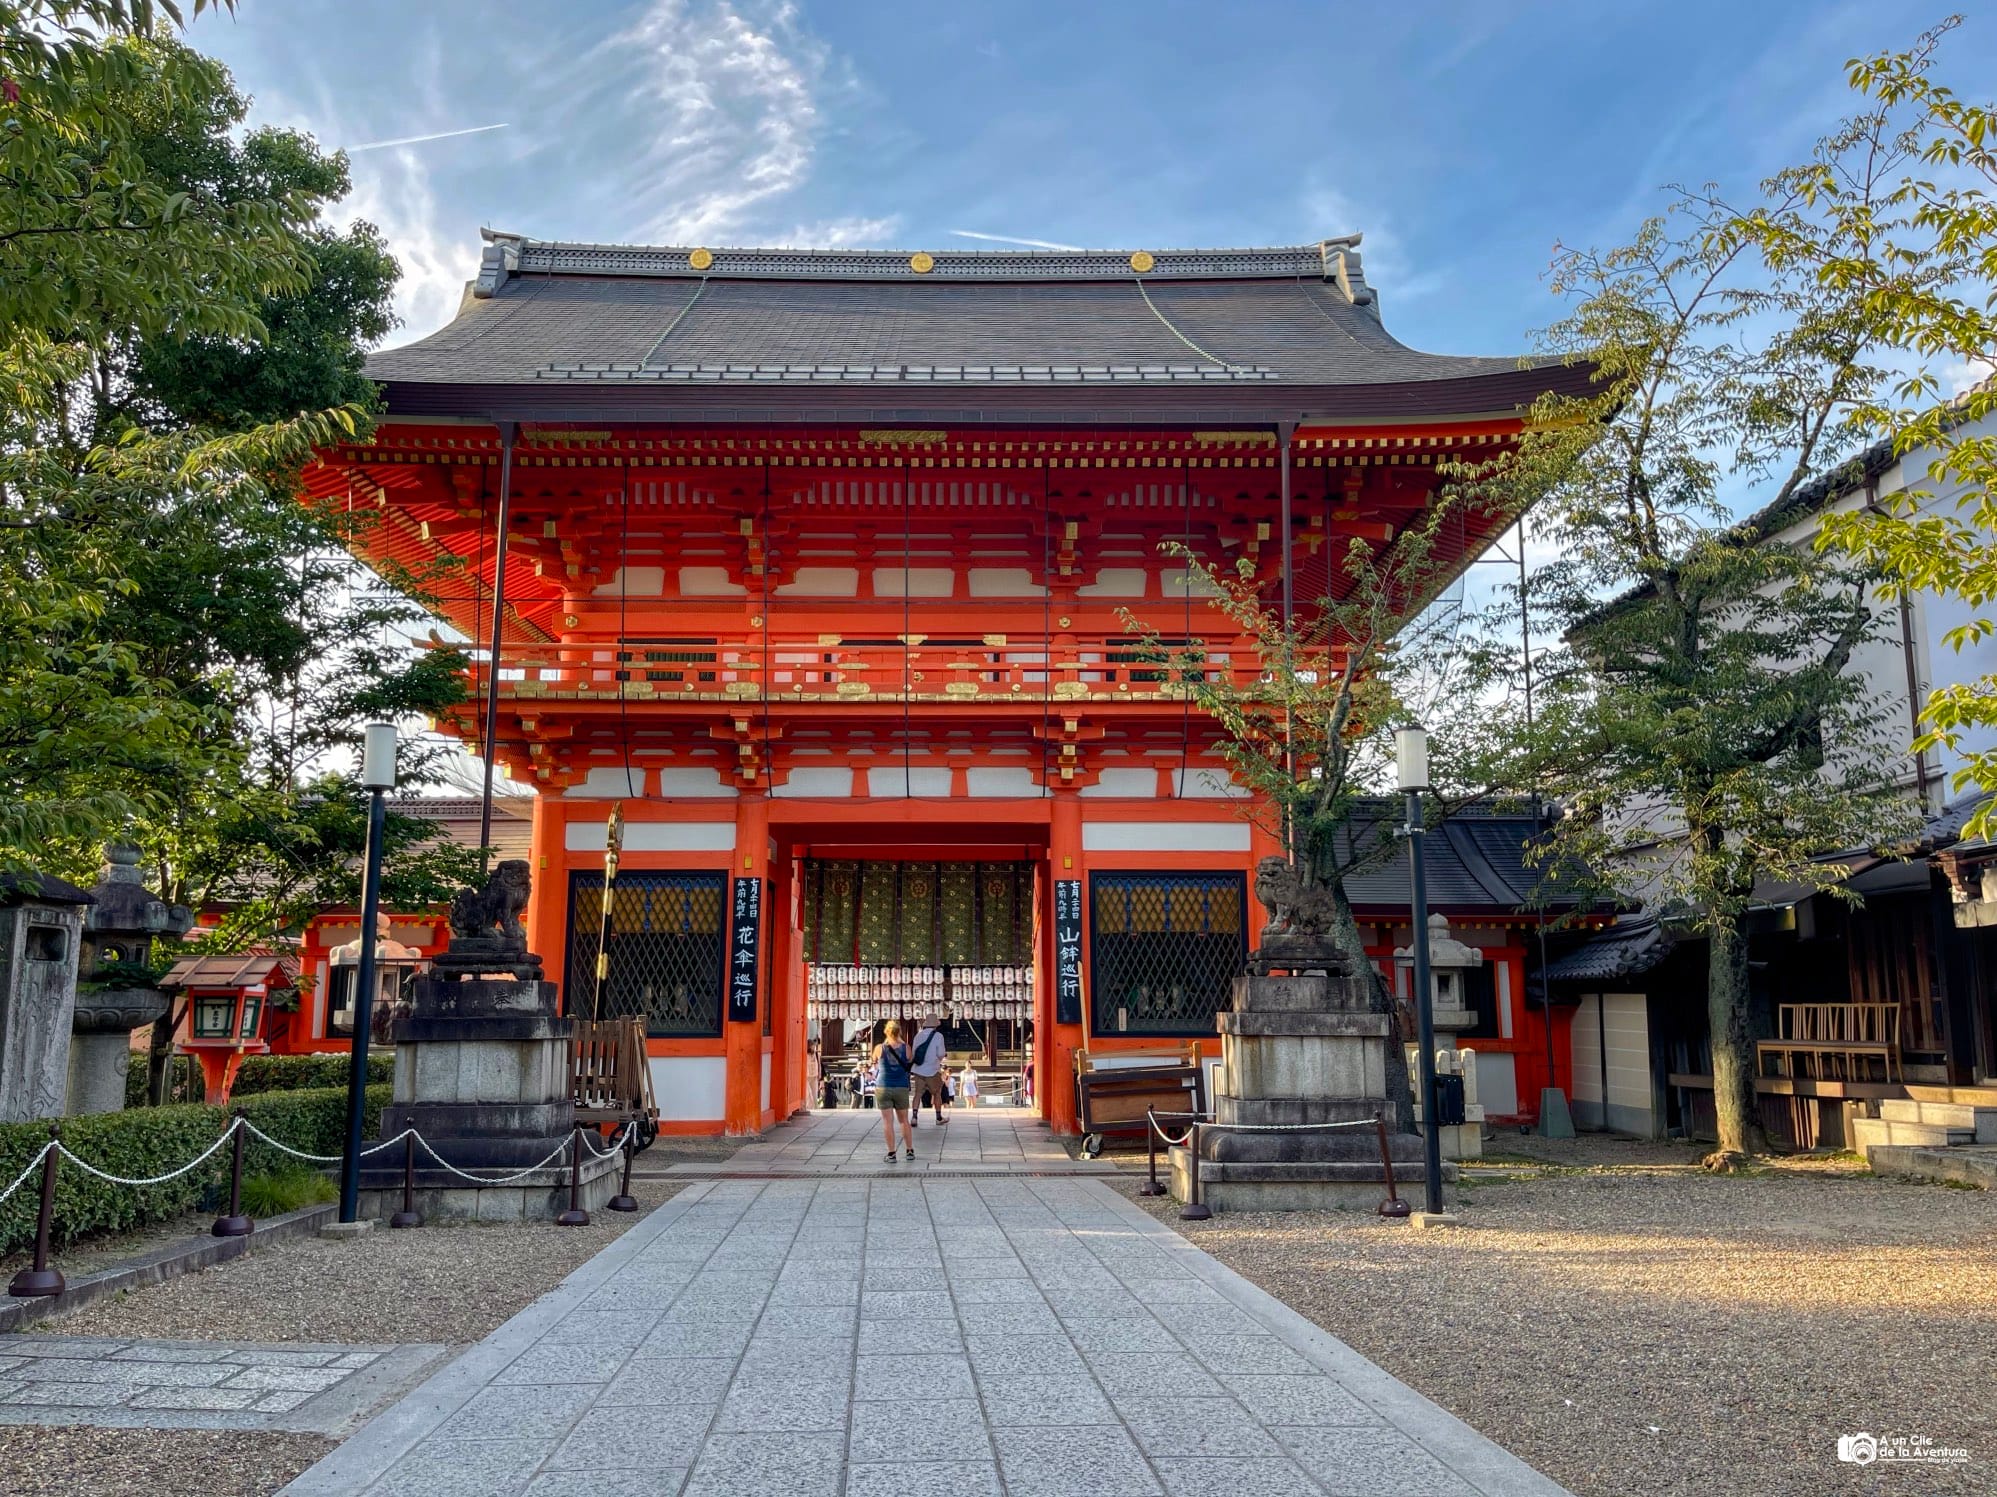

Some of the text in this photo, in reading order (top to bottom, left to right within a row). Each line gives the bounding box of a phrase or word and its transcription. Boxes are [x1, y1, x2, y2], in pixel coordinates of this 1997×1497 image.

[733, 925, 756, 1007] 花傘巡行
[1059, 926, 1081, 997] 山鉾巡行
